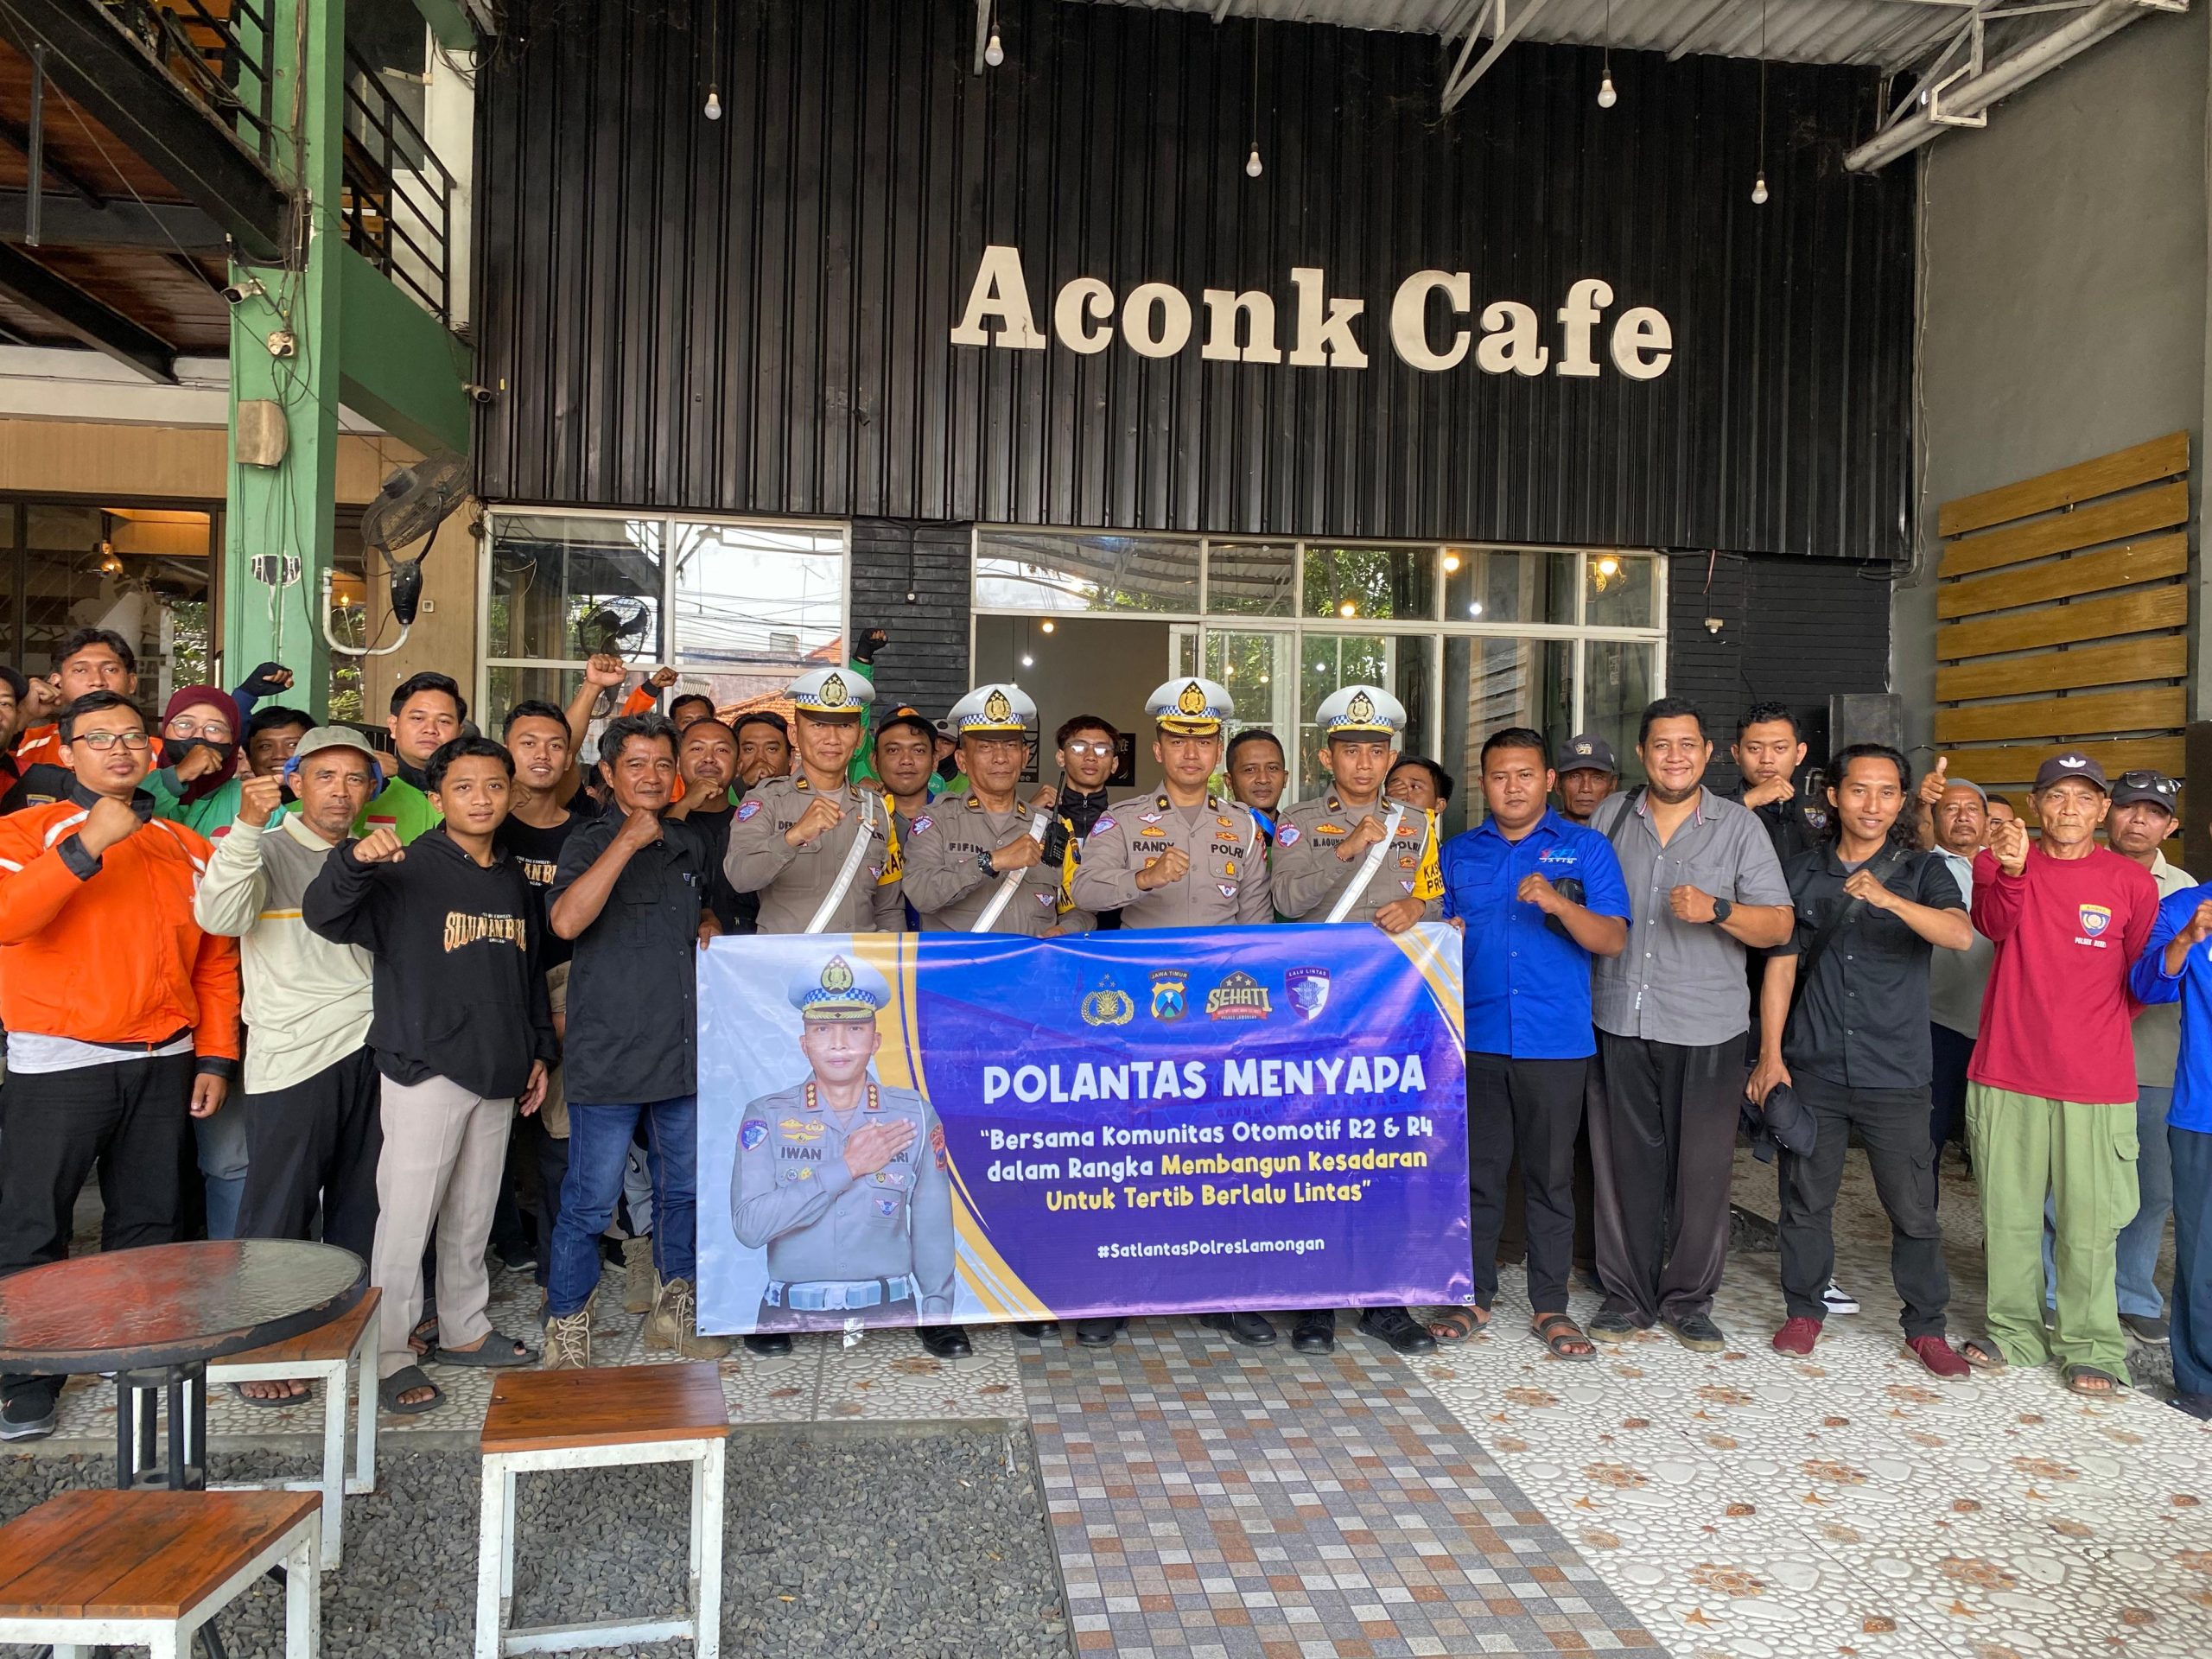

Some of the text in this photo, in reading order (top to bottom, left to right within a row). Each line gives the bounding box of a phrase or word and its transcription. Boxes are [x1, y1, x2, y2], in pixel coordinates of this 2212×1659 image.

[950, 245, 1675, 381] Aconk Cafe
[949, 842, 983, 854] FIFIN
[1211, 843, 1244, 859] POLRI
[1151, 971, 1168, 980] JAWA
[1205, 988, 1273, 1014] SEHATI
[983, 1054, 1427, 1104] POLANTAS MENYAPA
[980, 1116, 1433, 1150] "Bersama Komunitas Otomotif R2 & R4
[780, 1147, 822, 1160] IWAN
[987, 1147, 1427, 1183] dalam Rangka Membangun Kesadaran
[1046, 1179, 1371, 1211] Untuk Tertib Berlalu Lintas"
[1097, 1238, 1325, 1259] #SatlantasPolresLamongan
